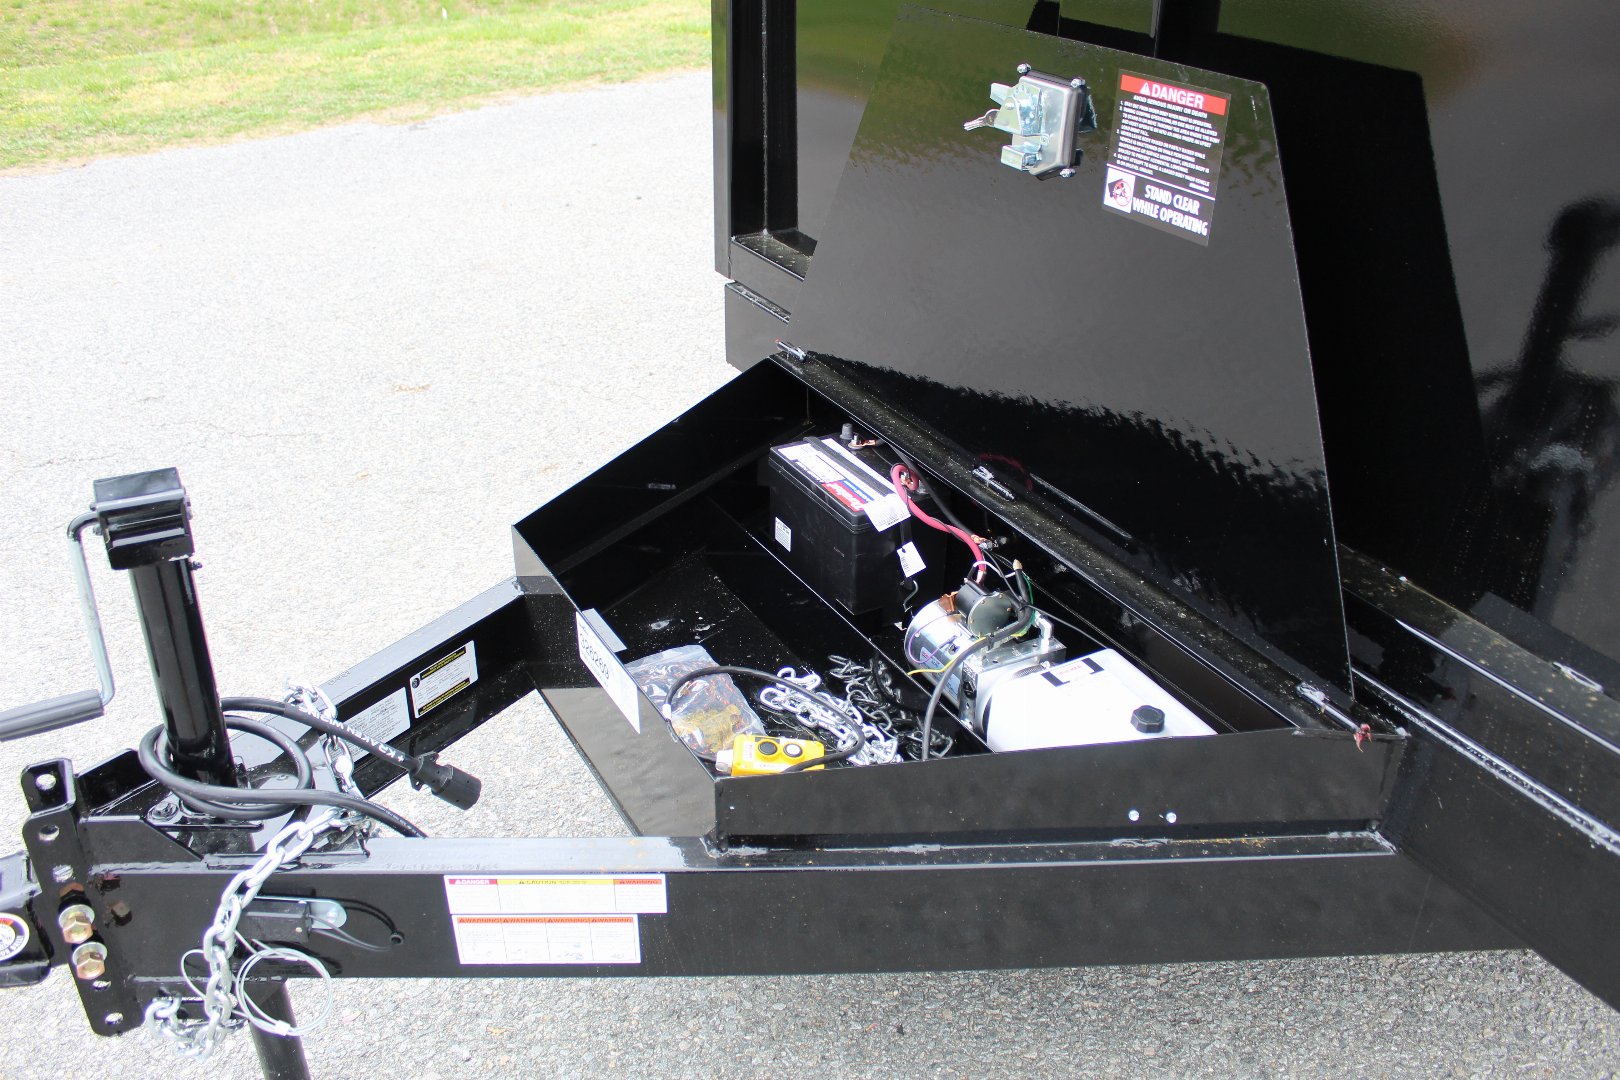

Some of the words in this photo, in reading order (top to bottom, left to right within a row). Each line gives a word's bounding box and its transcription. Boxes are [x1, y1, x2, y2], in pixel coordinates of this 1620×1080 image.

[1151, 84, 1204, 109] DANGER
[1191, 109, 1207, 119] DEATH
[1145, 184, 1172, 205] STAND
[1173, 194, 1200, 215] CLEAR
[1133, 197, 1160, 218] WHILE
[1160, 207, 1208, 236] OPERATING
